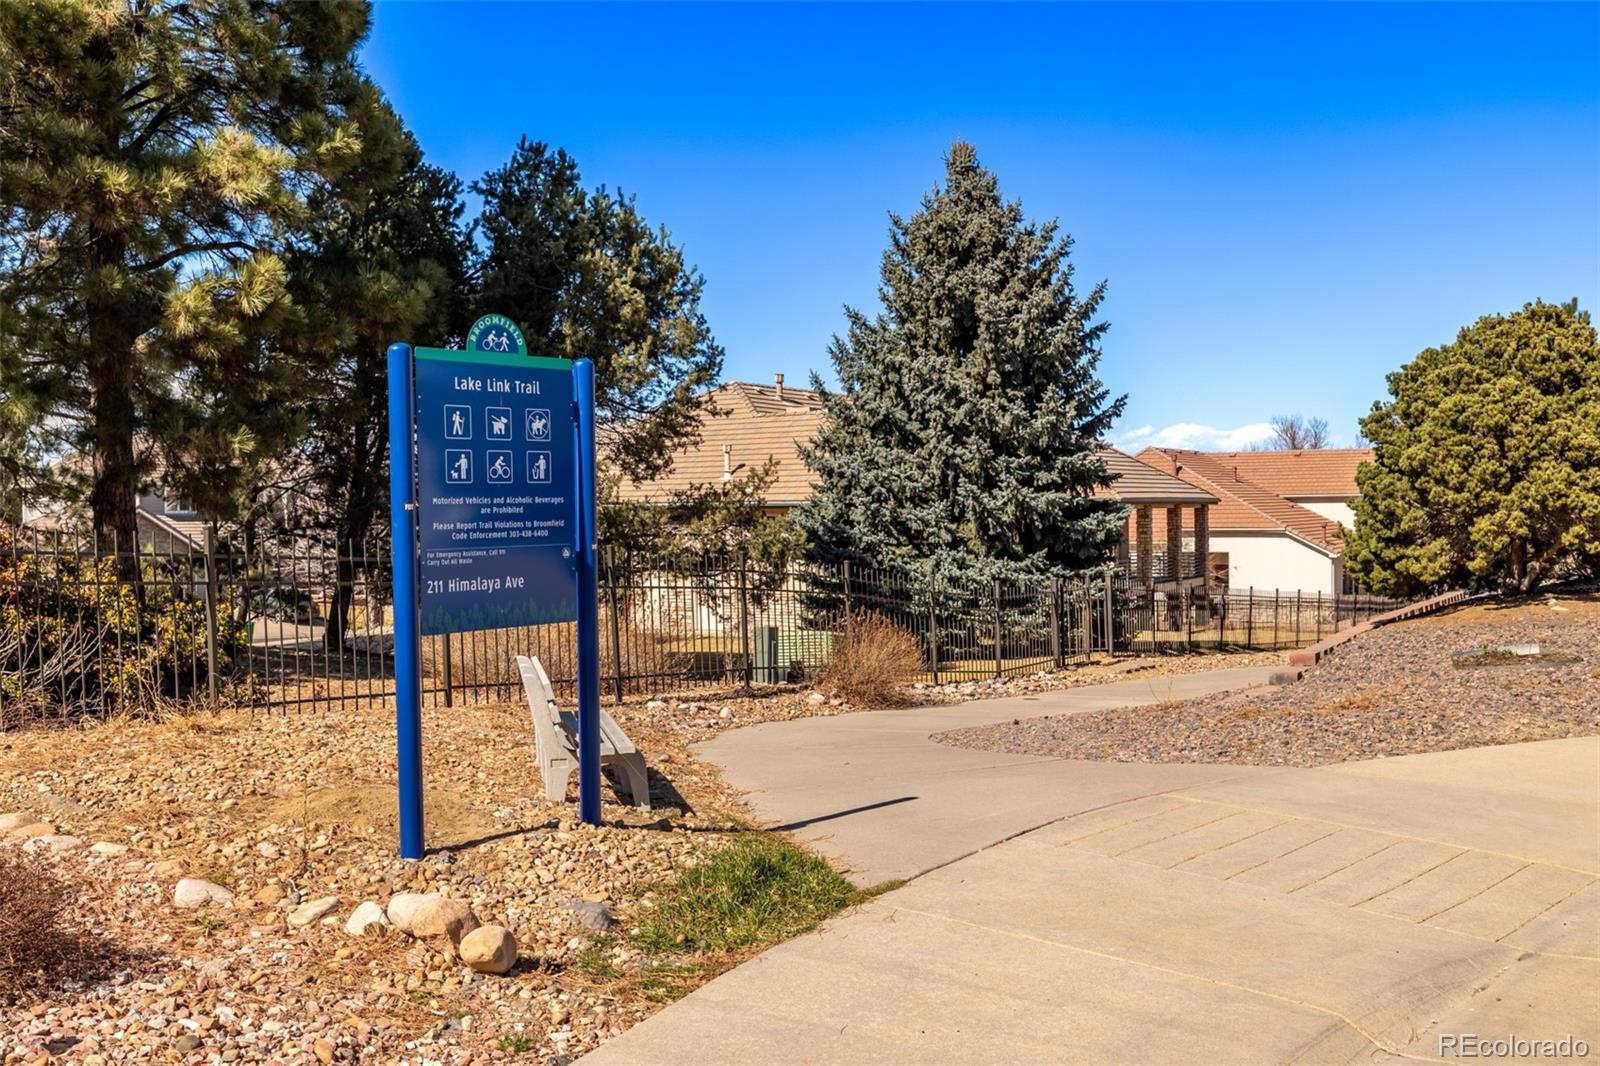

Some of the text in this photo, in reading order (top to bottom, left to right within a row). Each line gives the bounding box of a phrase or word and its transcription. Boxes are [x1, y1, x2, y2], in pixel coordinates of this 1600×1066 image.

[470, 316, 523, 346] BROOMFIELD
[454, 376, 541, 395] Lake Link Trail
[432, 495, 564, 505] Motorized Vehicles and Alcoholic Beverages
[432, 519, 565, 531] Please Report Trail Violations to Broomfield
[451, 529, 549, 540] Code Enforcement 303-438-6400
[436, 551, 461, 559] Emergency
[427, 576, 525, 594] 211 Himalaya Ave
